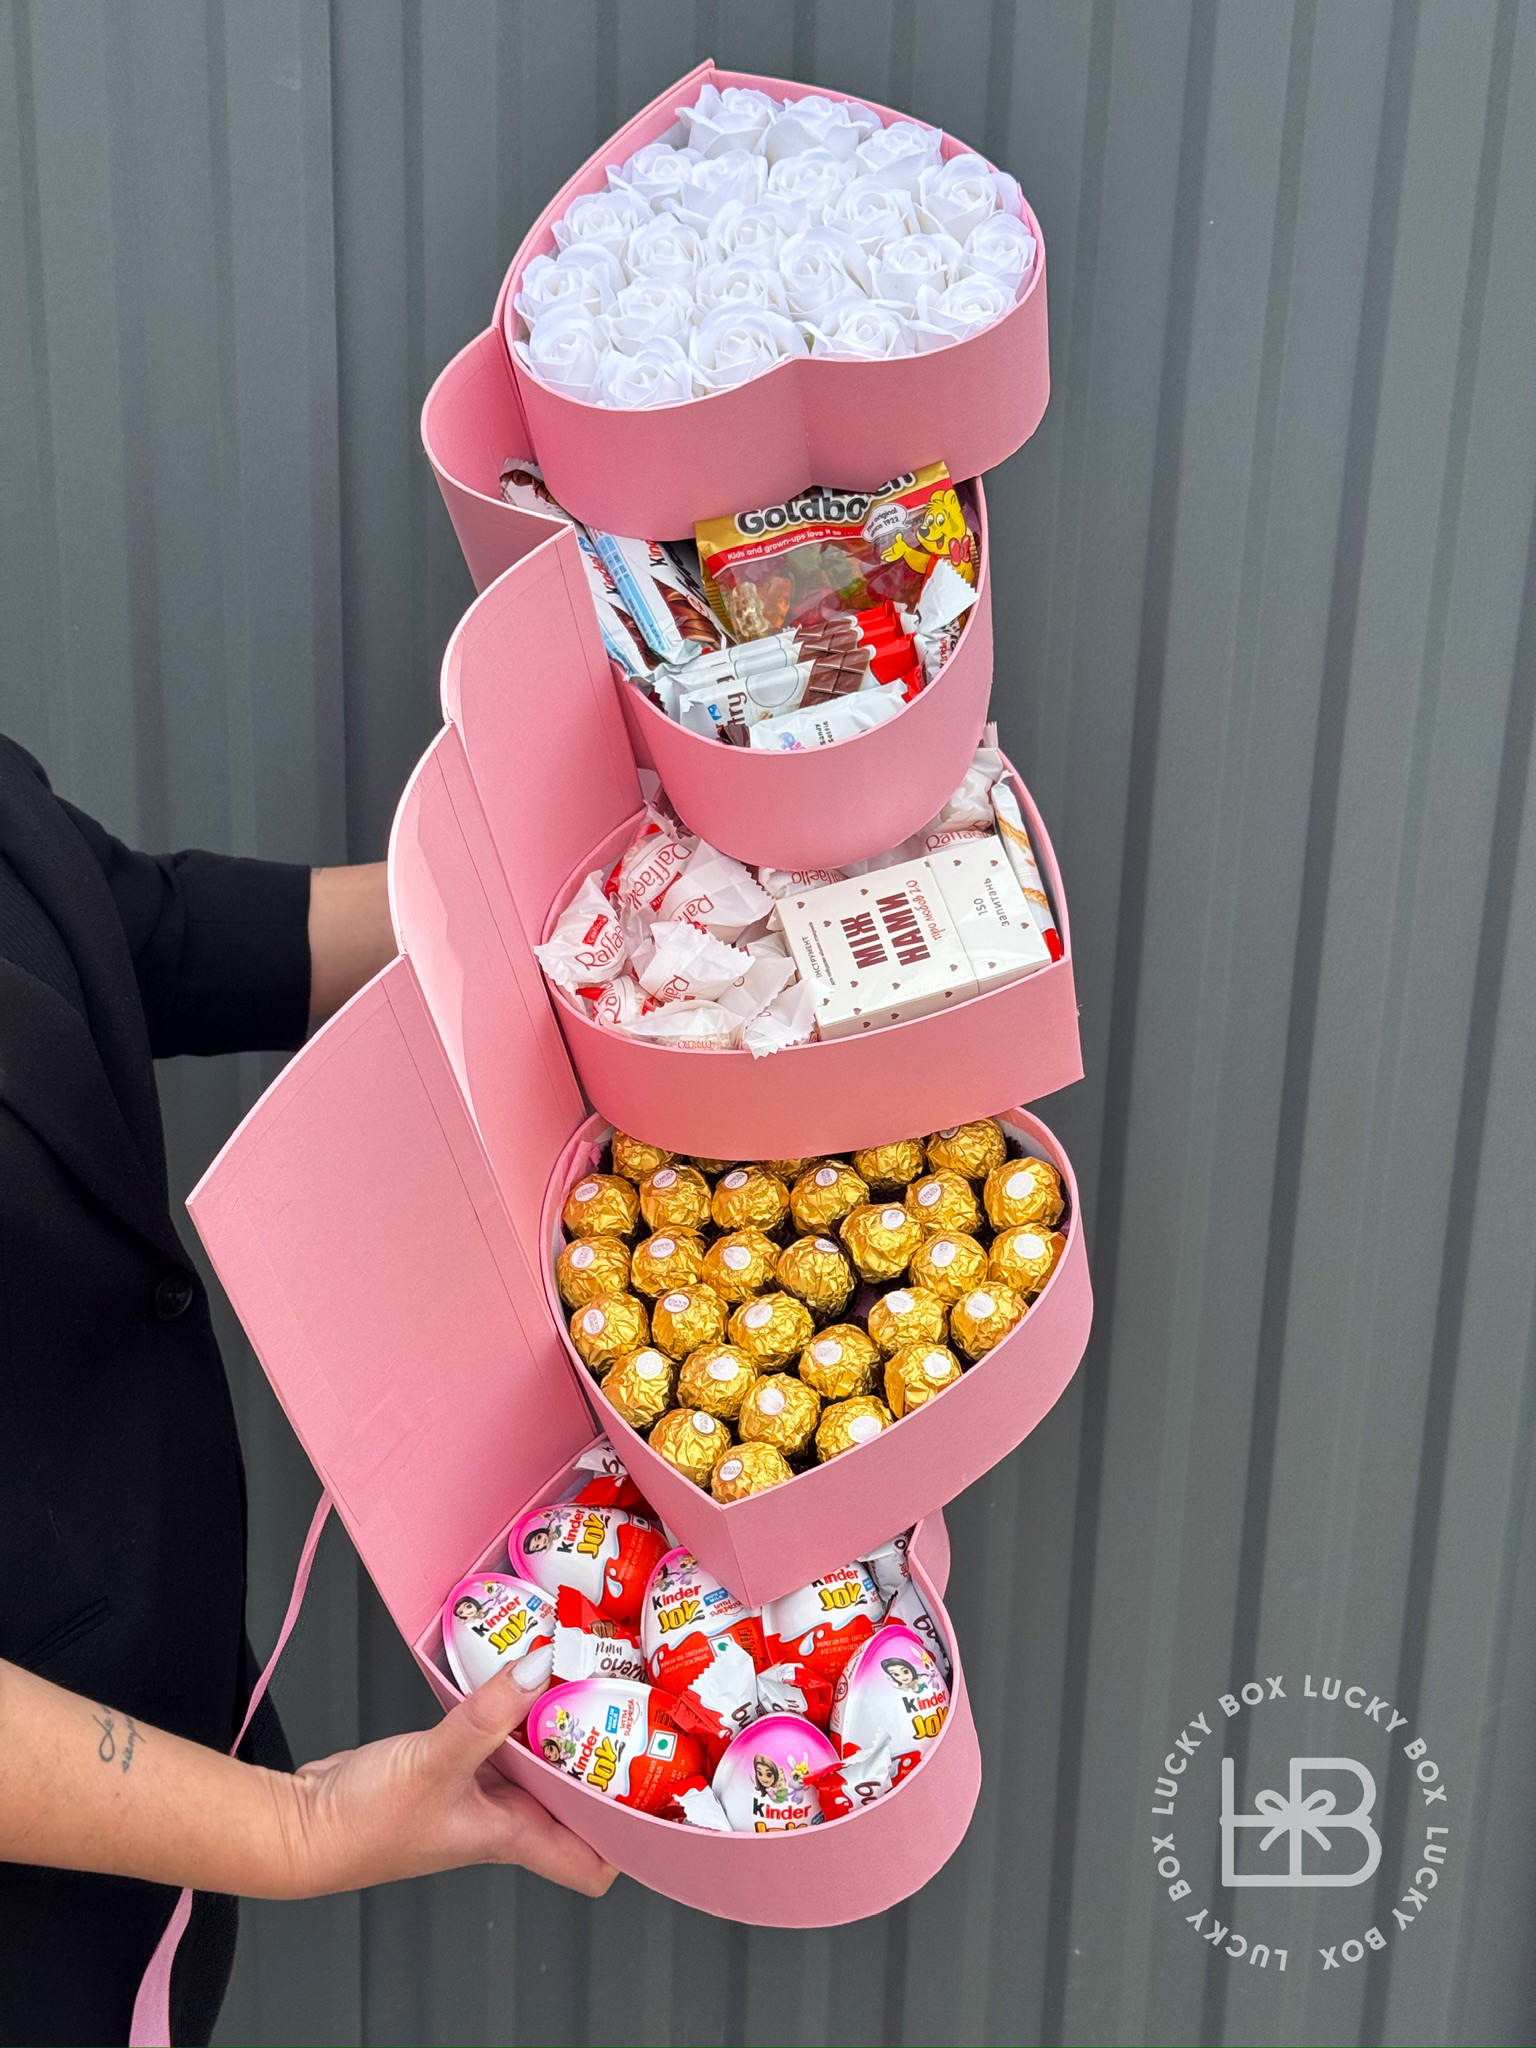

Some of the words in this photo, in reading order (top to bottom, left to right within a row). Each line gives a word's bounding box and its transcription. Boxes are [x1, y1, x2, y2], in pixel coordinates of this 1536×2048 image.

[874, 506, 898, 522] original
[883, 516, 900, 527] 1922
[727, 549, 746, 561] Kids
[747, 545, 763, 556] and
[764, 534, 806, 554] grown-ups
[913, 895, 935, 924] любов
[973, 897, 988, 916] 150
[983, 877, 1010, 928] запитань
[840, 911, 889, 970] МІЖ
[875, 891, 932, 967] НАМИ
[929, 923, 946, 941] про
[577, 1513, 607, 1560] JOY
[818, 1581, 862, 1612] JOY
[488, 1609, 527, 1655] JOY
[657, 1600, 701, 1634] JOY
[595, 1641, 623, 1657] mini
[587, 1736, 618, 1792] JOY
